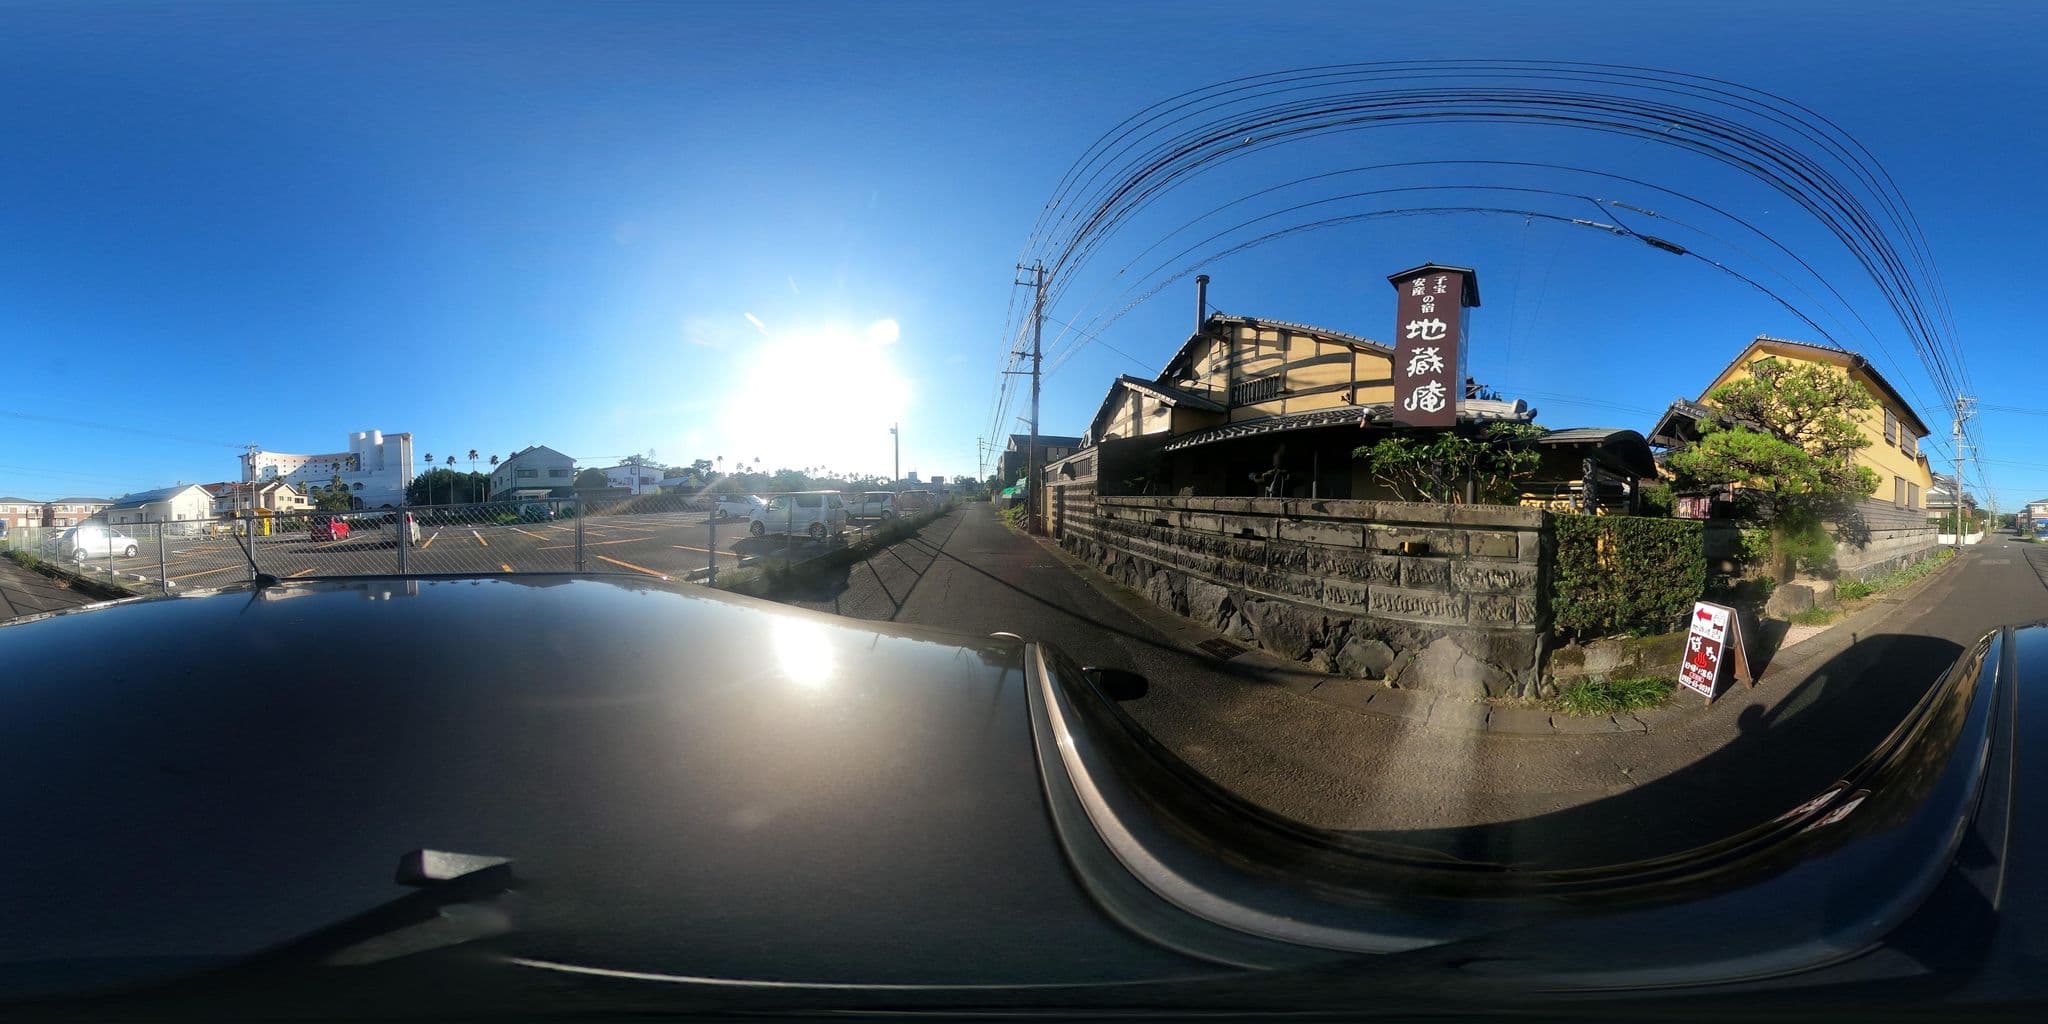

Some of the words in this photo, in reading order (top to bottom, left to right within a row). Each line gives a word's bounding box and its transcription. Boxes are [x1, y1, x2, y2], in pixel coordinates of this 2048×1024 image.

[1412, 277, 1426, 296] 安産
[1433, 275, 1448, 294] 子宝
[1421, 295, 1435, 314] の宿
[1404, 317, 1447, 413] 地蔵庵
